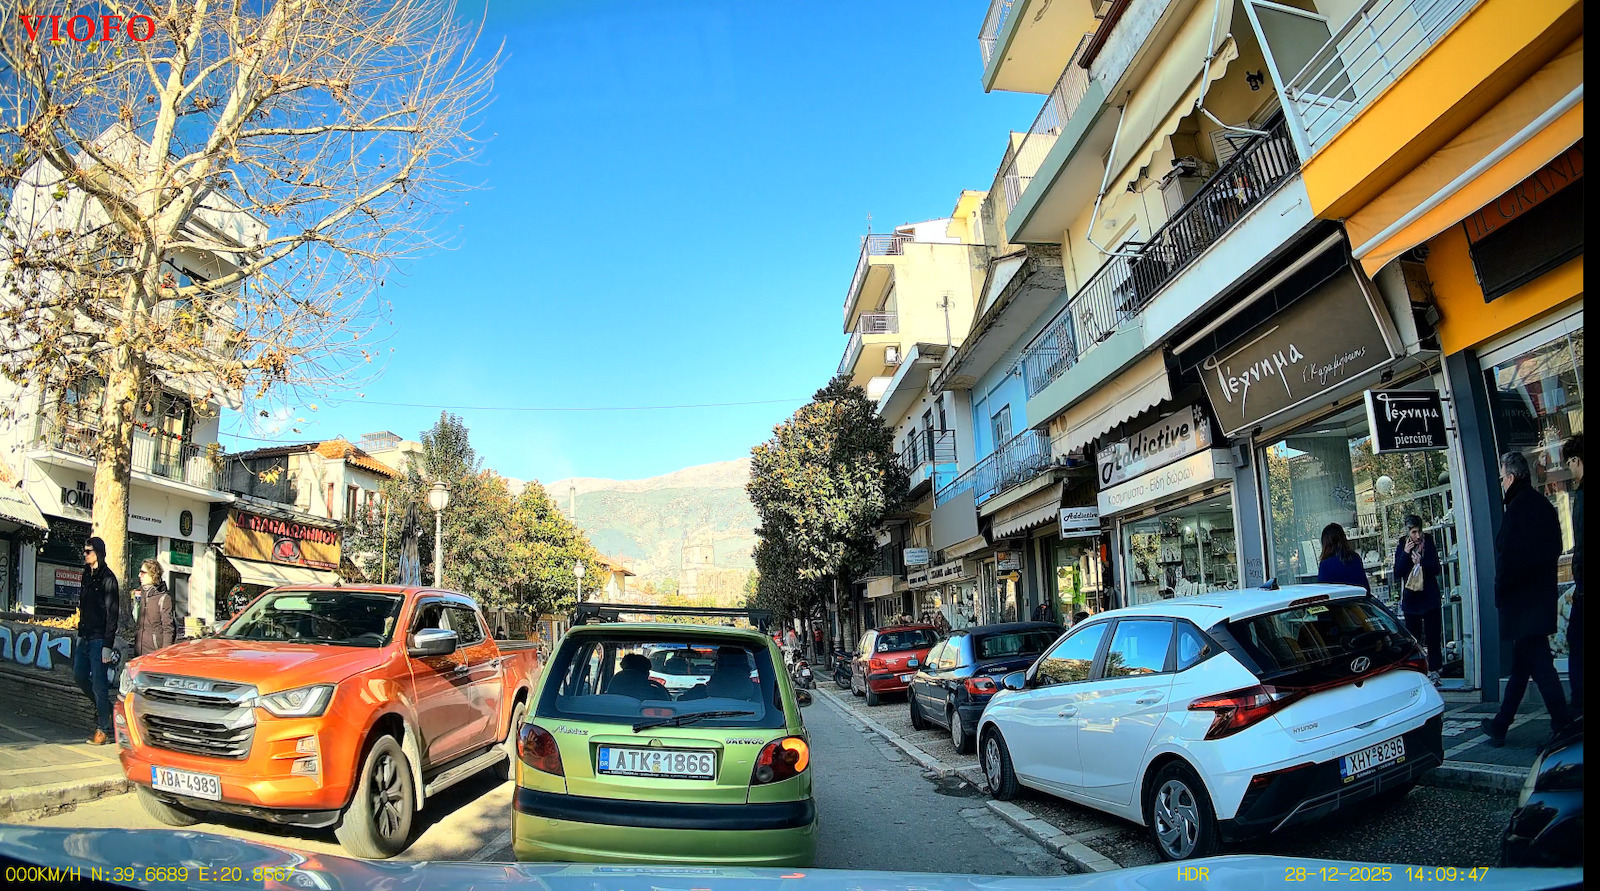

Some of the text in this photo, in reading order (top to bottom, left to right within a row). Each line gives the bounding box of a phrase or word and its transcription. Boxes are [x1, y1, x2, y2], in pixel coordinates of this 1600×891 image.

[1471, 209, 1496, 238] IL
[1203, 324, 1304, 418] Τέχνημα
[1376, 393, 1439, 433] Τέχνημα
[1394, 432, 1433, 448] piercing
[1102, 422, 1191, 485] Addictive
[1063, 511, 1098, 522] Addictive
[164, 678, 209, 692] ISUZU
[1293, 722, 1319, 734] HYUNDAI
[725, 737, 765, 745] DAEWOO
[159, 769, 217, 794] XBA-4989
